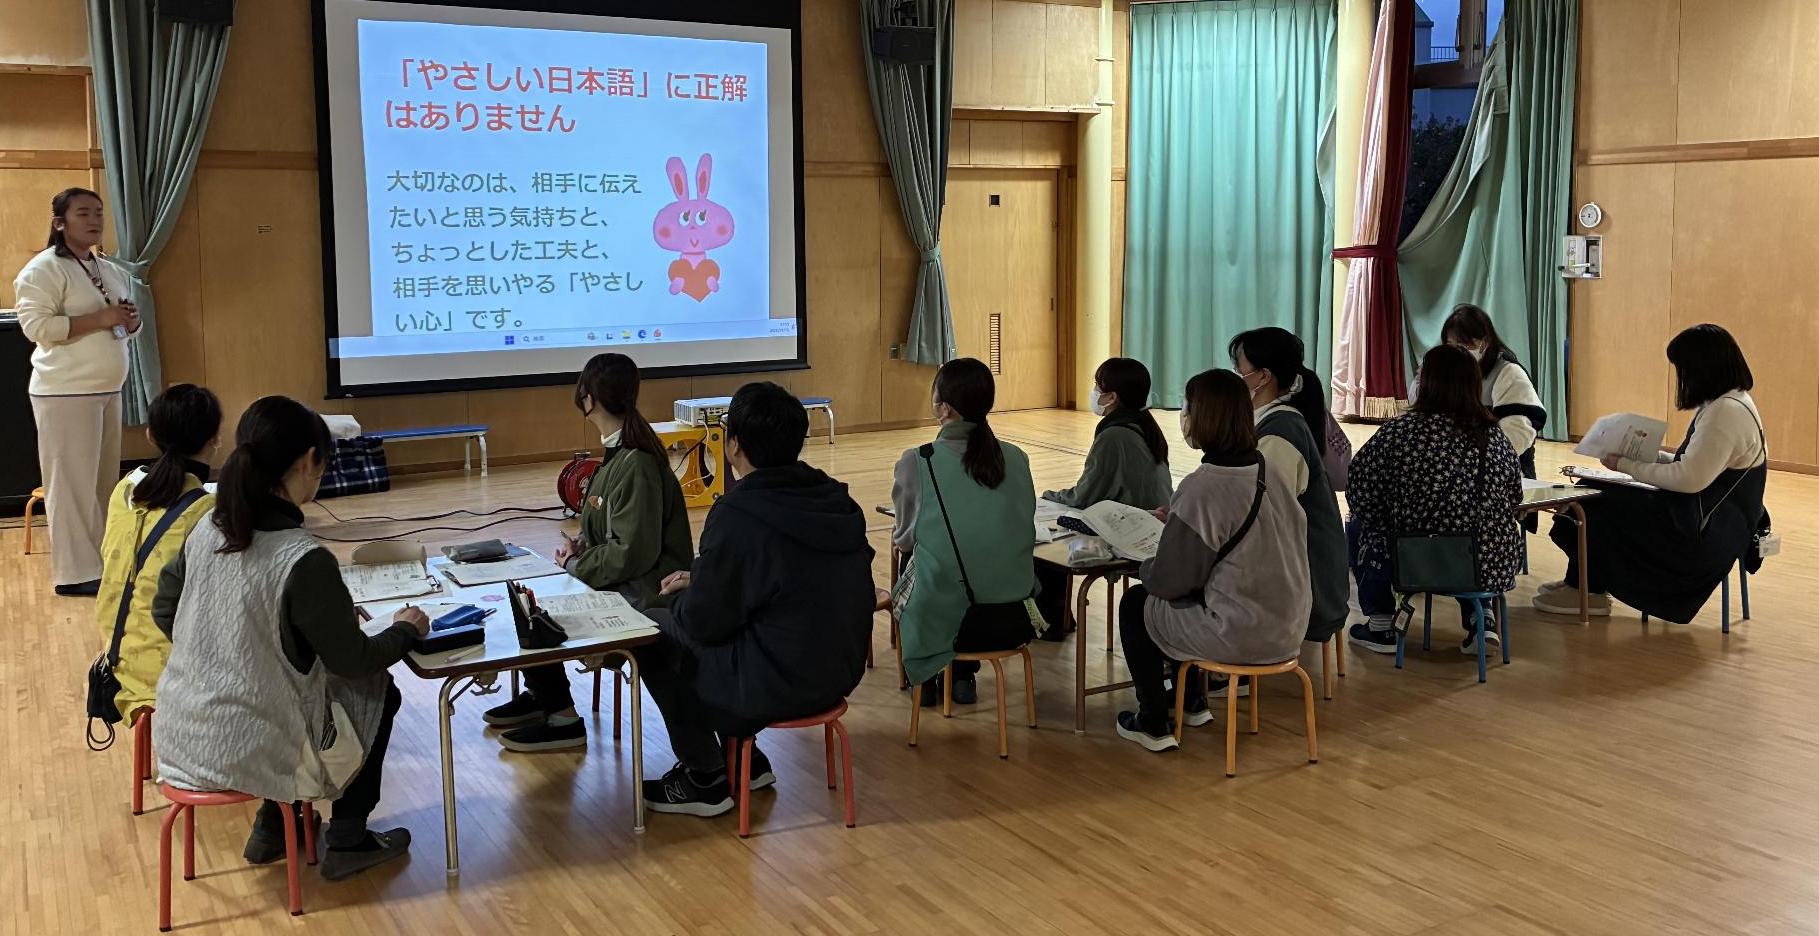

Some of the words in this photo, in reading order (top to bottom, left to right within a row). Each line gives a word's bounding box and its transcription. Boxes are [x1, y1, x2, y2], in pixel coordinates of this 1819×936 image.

[400, 58, 749, 102] 「やさしい日本語」に正解
[384, 100, 577, 133] はありません
[386, 170, 643, 194] 大切なのは、相手に伝え
[388, 205, 609, 229] たいと思う気持ちと、
[391, 239, 609, 264] ちょっとした工夫と、
[392, 271, 644, 299] 相手を思いやる「やさし
[394, 307, 526, 333] い心」です。
